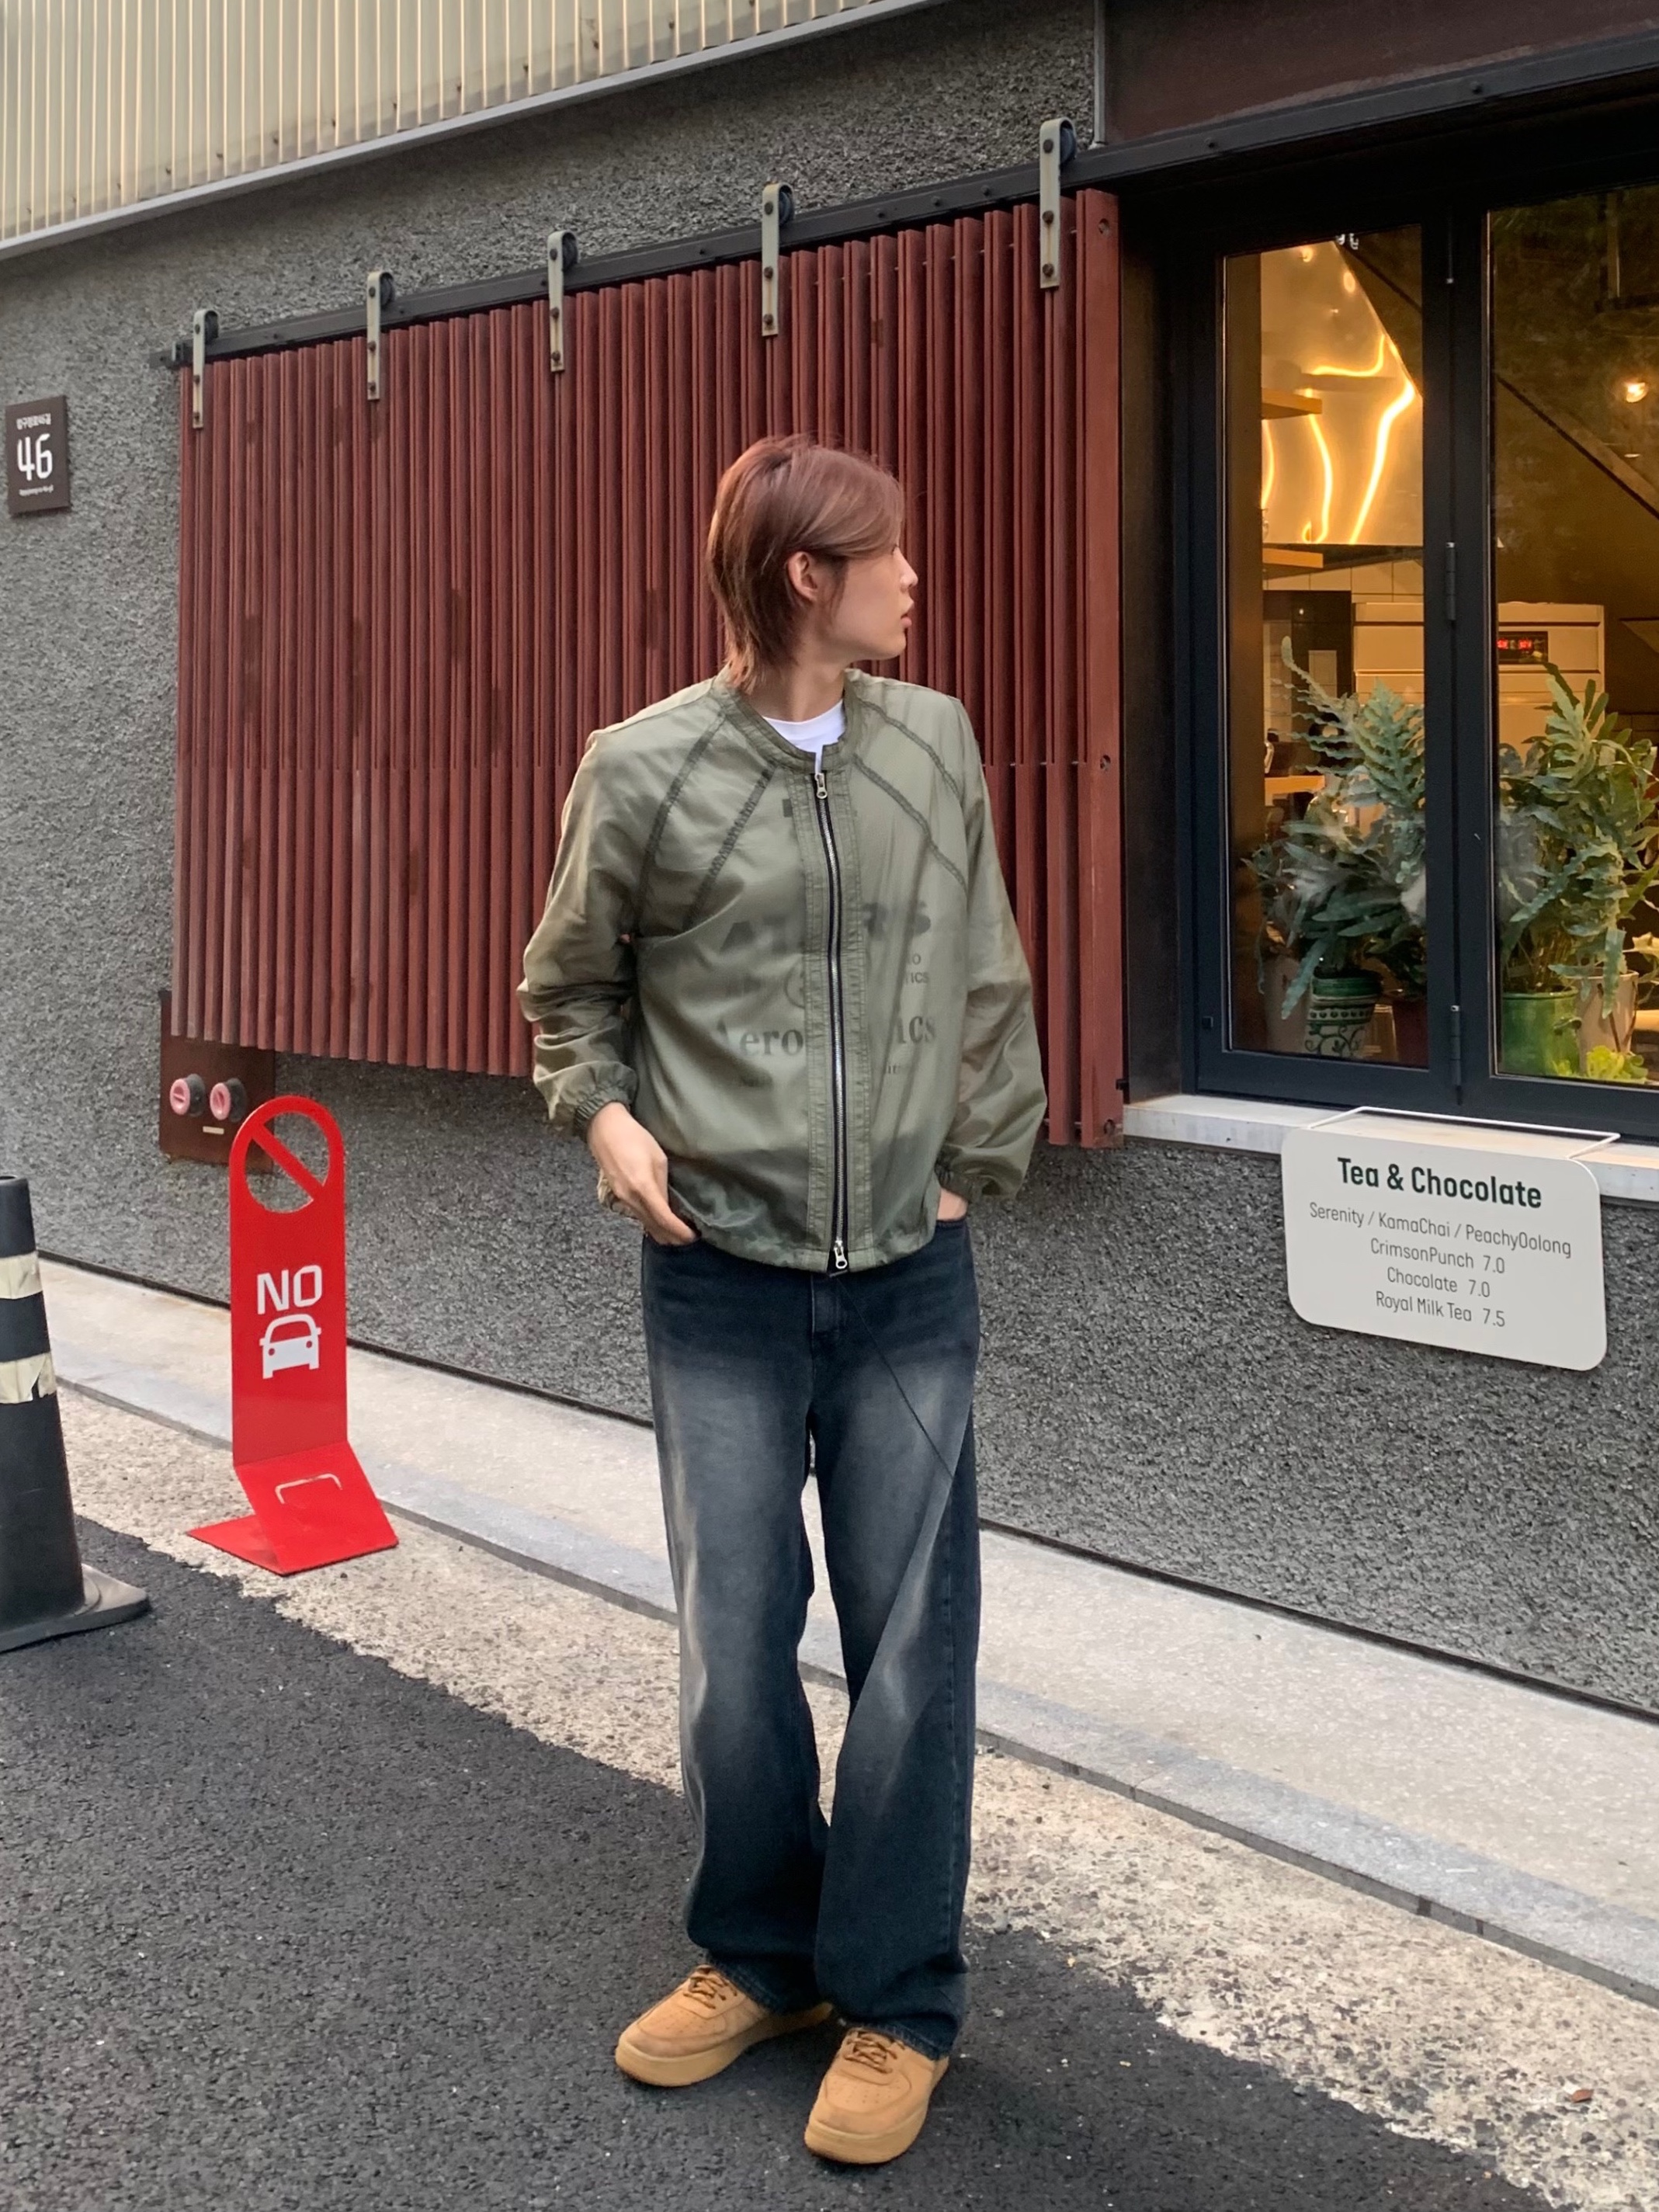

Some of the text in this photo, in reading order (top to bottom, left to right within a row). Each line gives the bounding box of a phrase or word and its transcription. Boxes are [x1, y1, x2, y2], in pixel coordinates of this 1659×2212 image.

[17, 433, 53, 481] 46
[1338, 1157, 1542, 1208] Tea & Chocolate
[1309, 1202, 1364, 1228] Serenity
[1378, 1211, 1450, 1237] KamaChai
[1466, 1224, 1571, 1259] PeachyOolong
[1371, 1238, 1505, 1274] CrimsonPunch 7.0
[257, 1265, 322, 1314] NO
[1387, 1266, 1490, 1297] Chocolate 7.0
[1376, 1290, 1505, 1327] Royal Milk Tea 7.5
